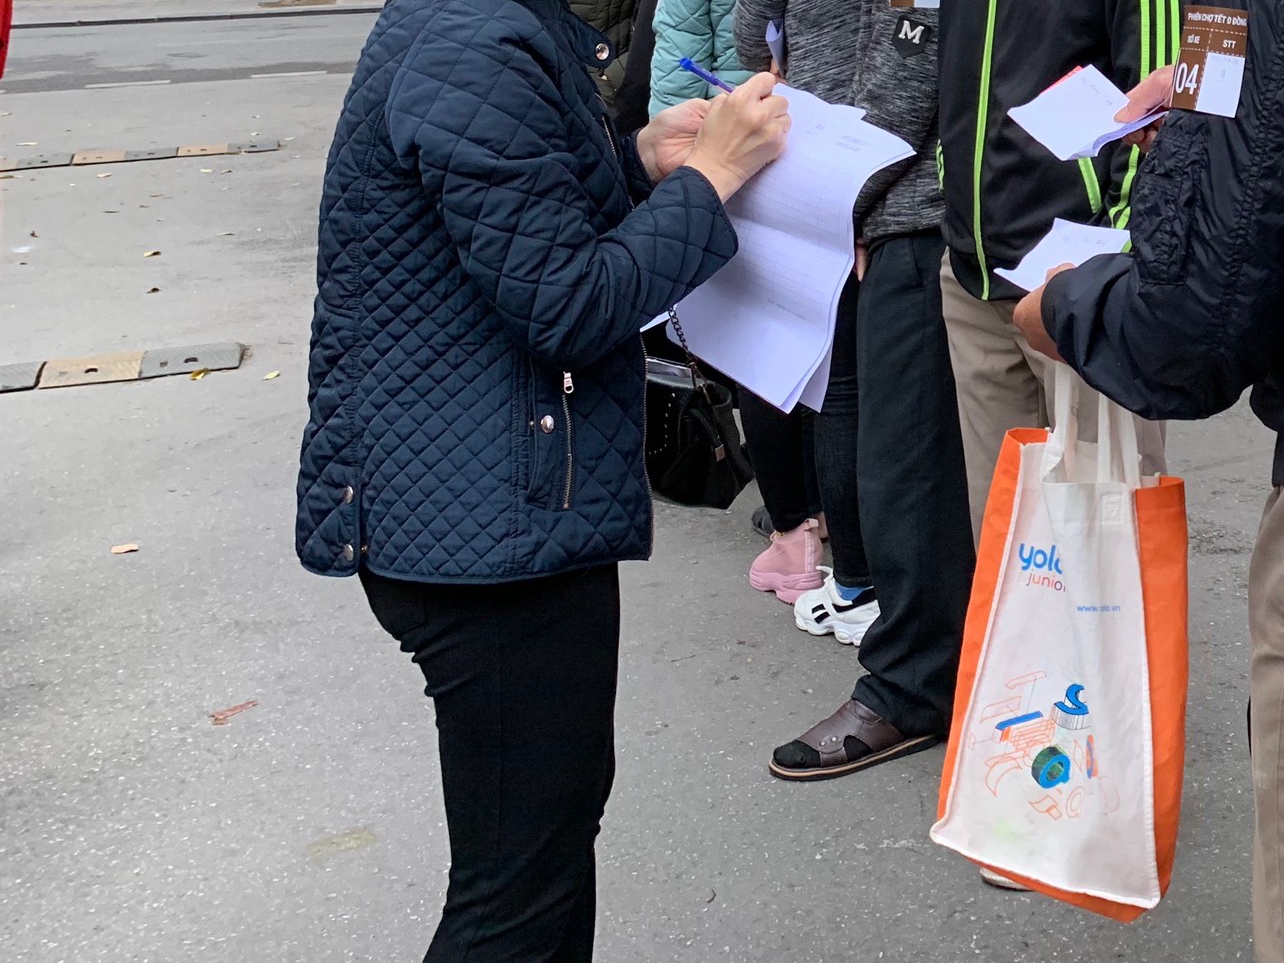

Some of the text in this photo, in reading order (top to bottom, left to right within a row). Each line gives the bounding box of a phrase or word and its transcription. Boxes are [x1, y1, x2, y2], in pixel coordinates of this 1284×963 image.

[898, 20, 925, 45] M
[1222, 39, 1237, 49] STT
[1175, 62, 1198, 95] 04
